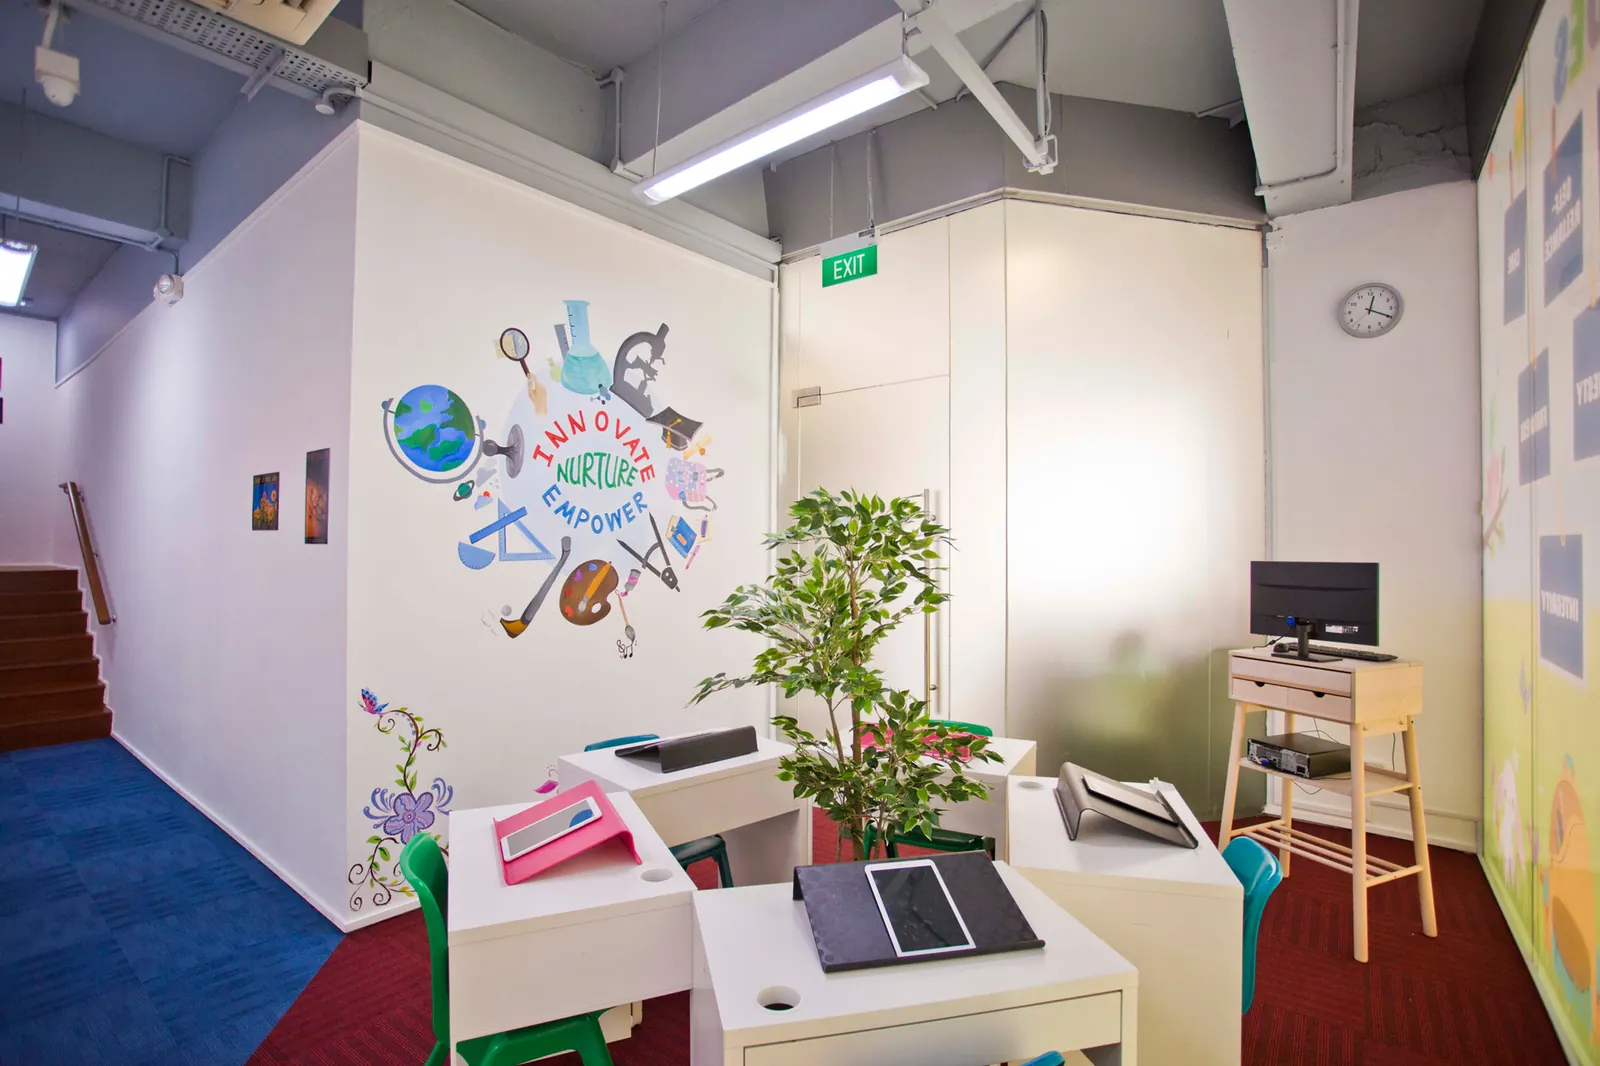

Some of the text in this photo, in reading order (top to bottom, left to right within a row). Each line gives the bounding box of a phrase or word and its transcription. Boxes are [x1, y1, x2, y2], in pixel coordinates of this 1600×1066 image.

[834, 253, 865, 280] EXIT
[532, 410, 656, 484] INNOVATE
[556, 451, 639, 490] NURTURE
[541, 483, 648, 535] EMPOWER
